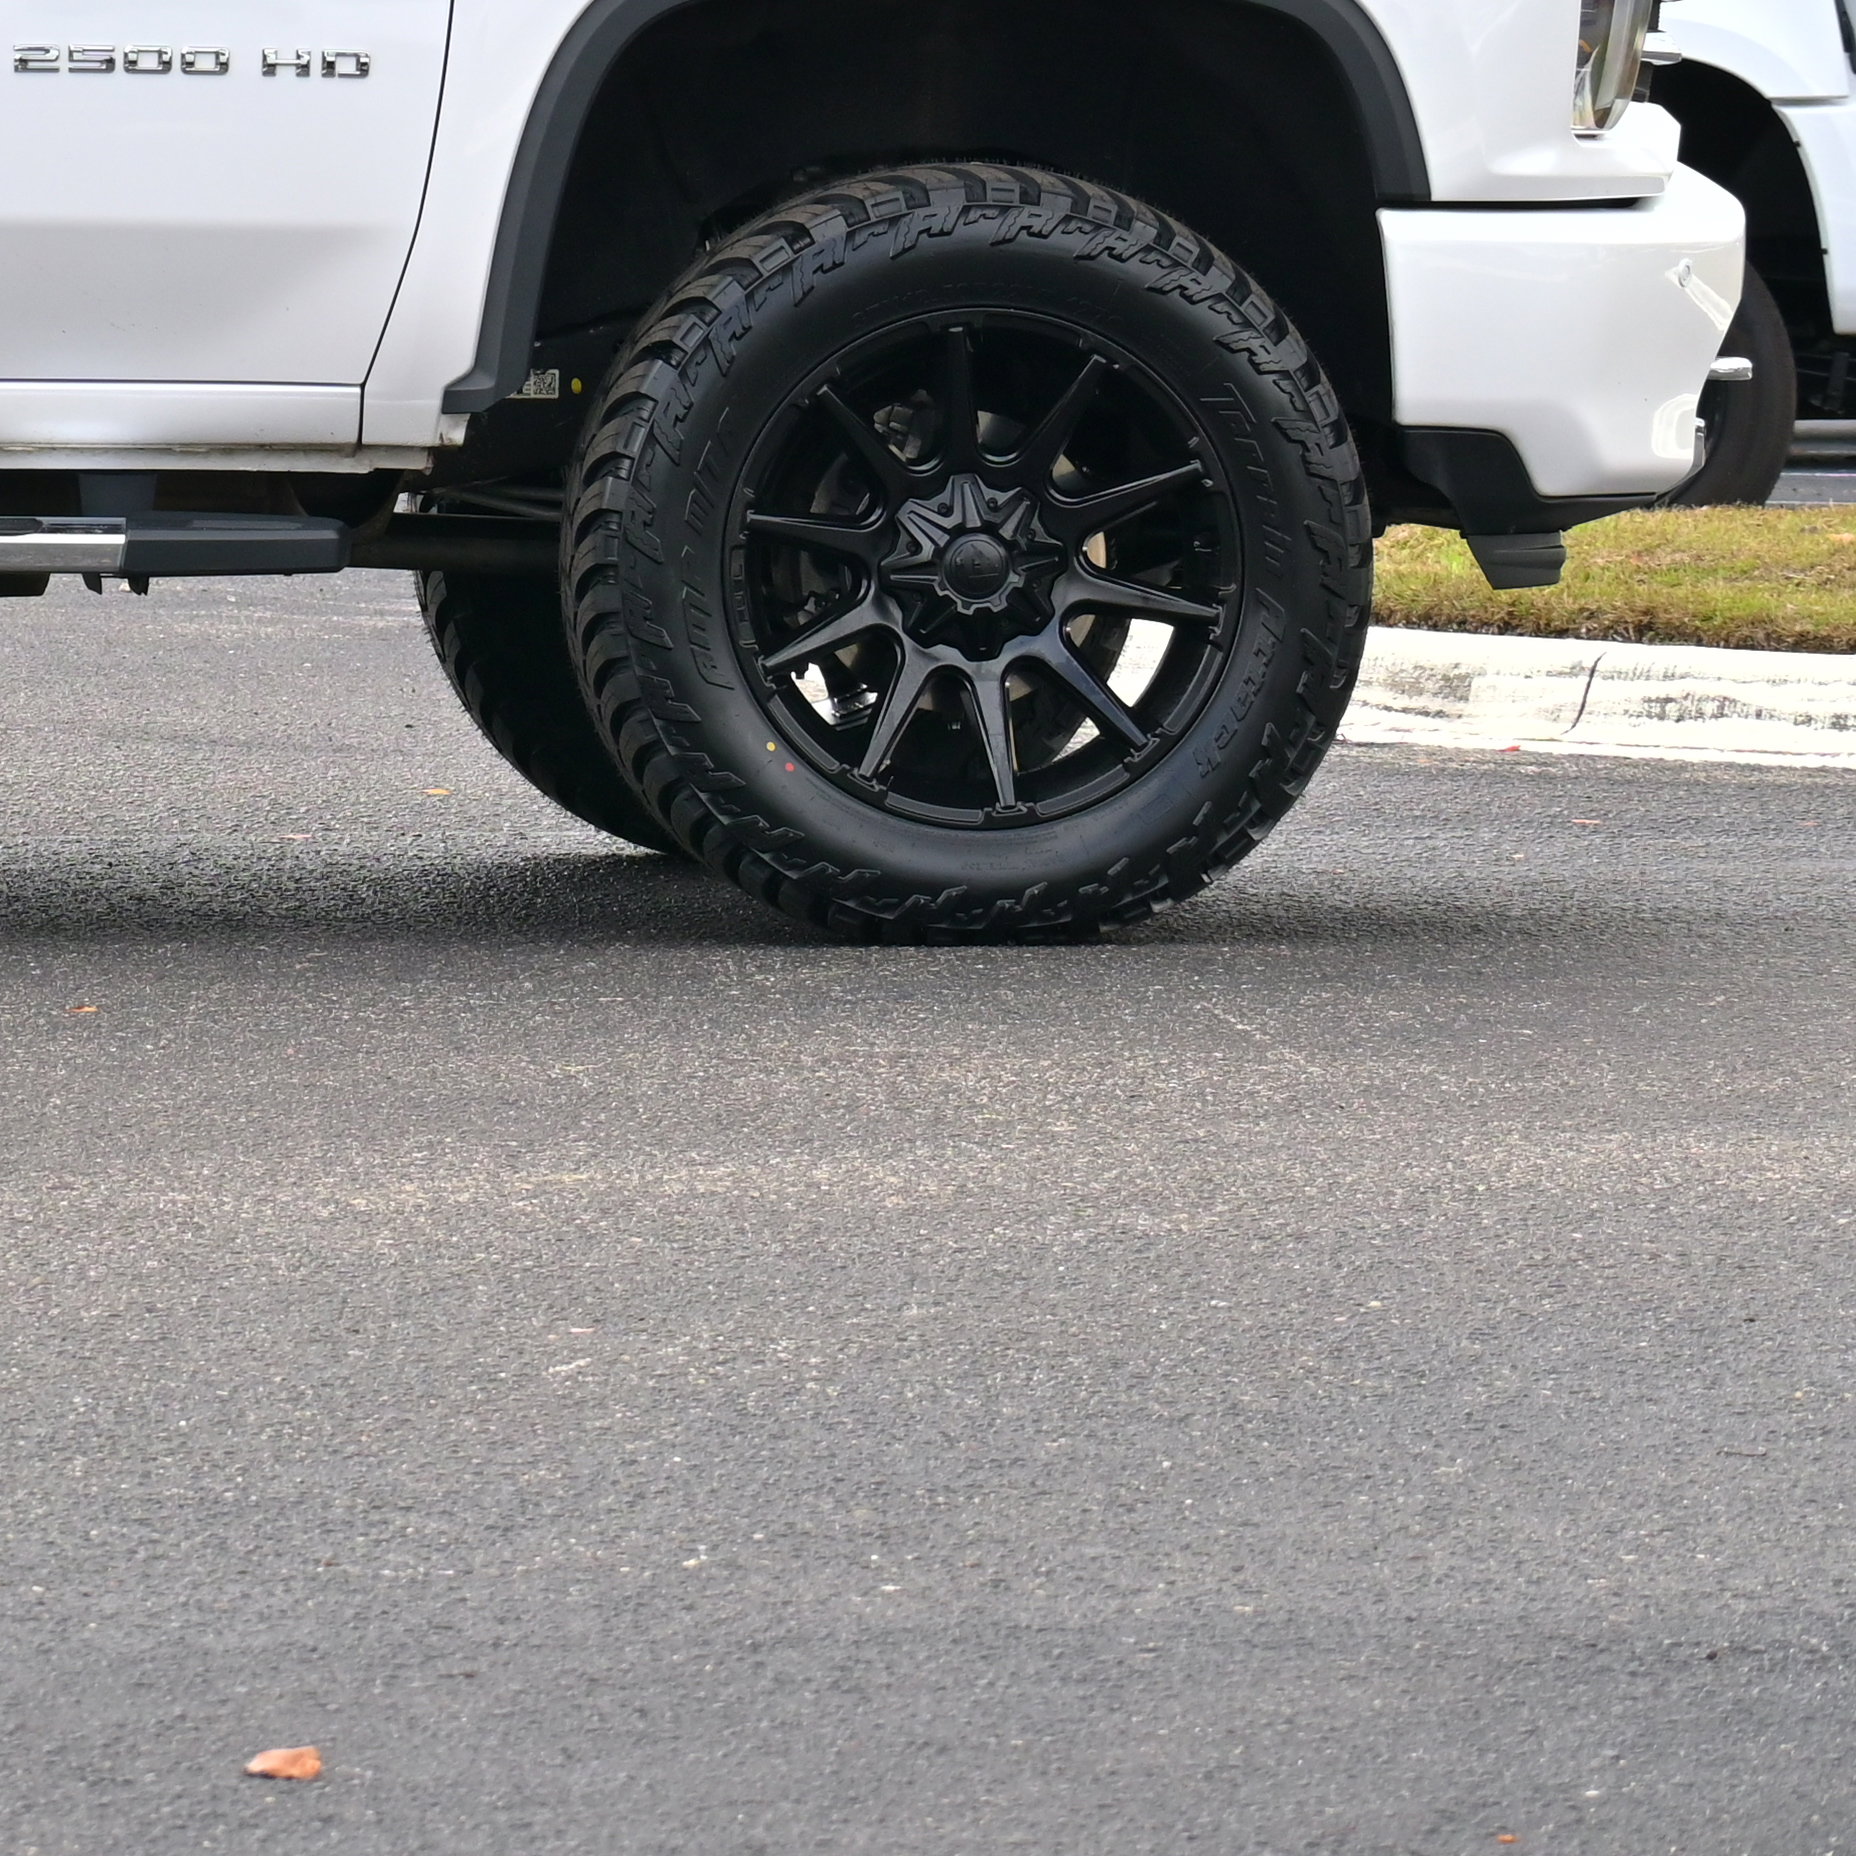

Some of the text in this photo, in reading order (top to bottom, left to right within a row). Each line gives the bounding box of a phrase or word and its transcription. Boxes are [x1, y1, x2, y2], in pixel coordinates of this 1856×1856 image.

[13, 43, 371, 78] 2500 HD
[1185, 381, 1291, 781] Terrain Attack
